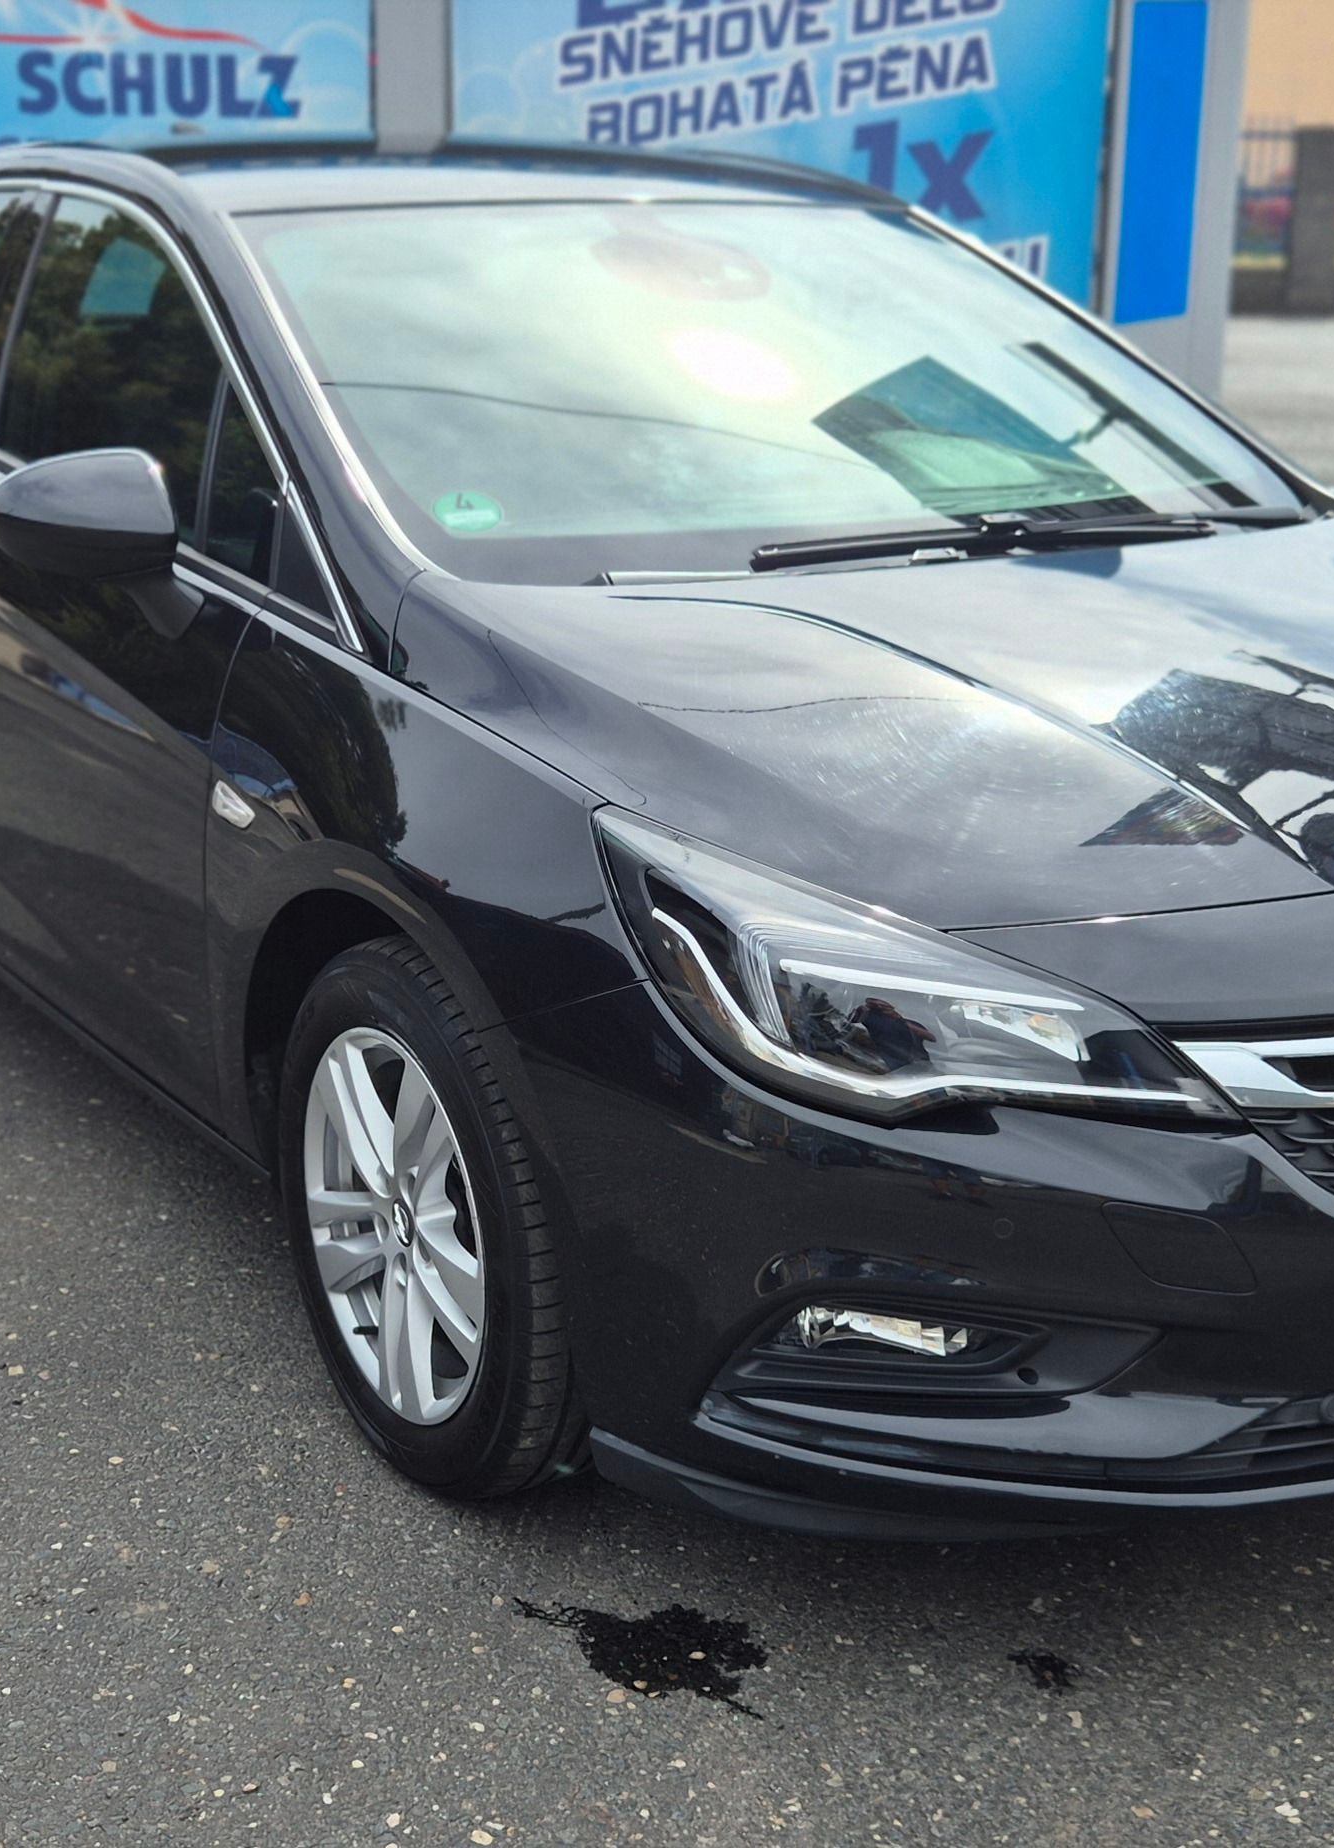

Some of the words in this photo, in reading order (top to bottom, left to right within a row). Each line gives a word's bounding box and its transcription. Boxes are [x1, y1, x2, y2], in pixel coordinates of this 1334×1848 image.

[18, 50, 301, 118] SCHULZ
[587, 60, 814, 146] BOHATÁ
[836, 36, 989, 108] PĚNA
